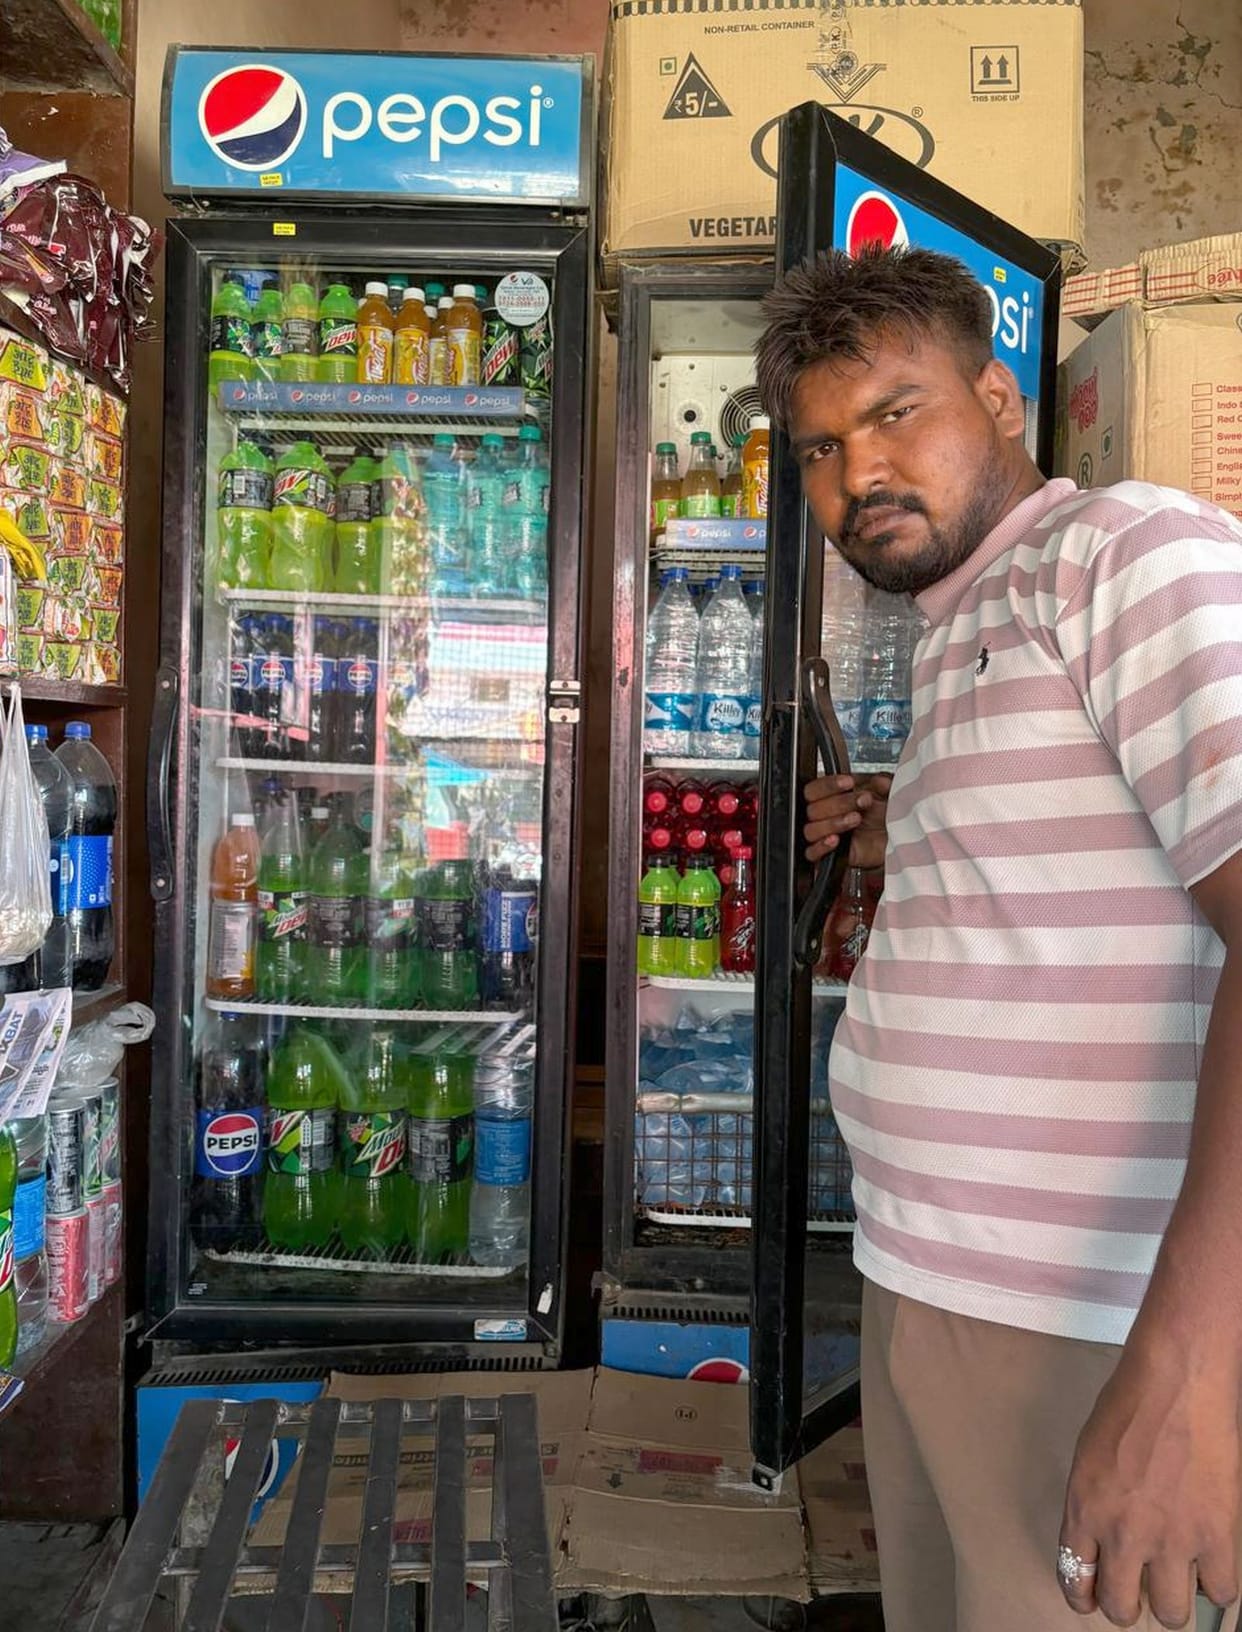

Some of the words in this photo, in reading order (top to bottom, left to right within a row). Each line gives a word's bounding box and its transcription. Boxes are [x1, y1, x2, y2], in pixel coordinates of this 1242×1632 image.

[704, 24, 760, 34] NON-RETAIL
[761, 21, 815, 31] CONTAINER
[323, 85, 542, 162] pepsi
[363, 393, 393, 404] pepsi
[421, 395, 451, 405] pepsi
[479, 397, 510, 407] pepsi
[1217, 415, 1235, 424] Red
[207, 1131, 257, 1150] PEPSI
